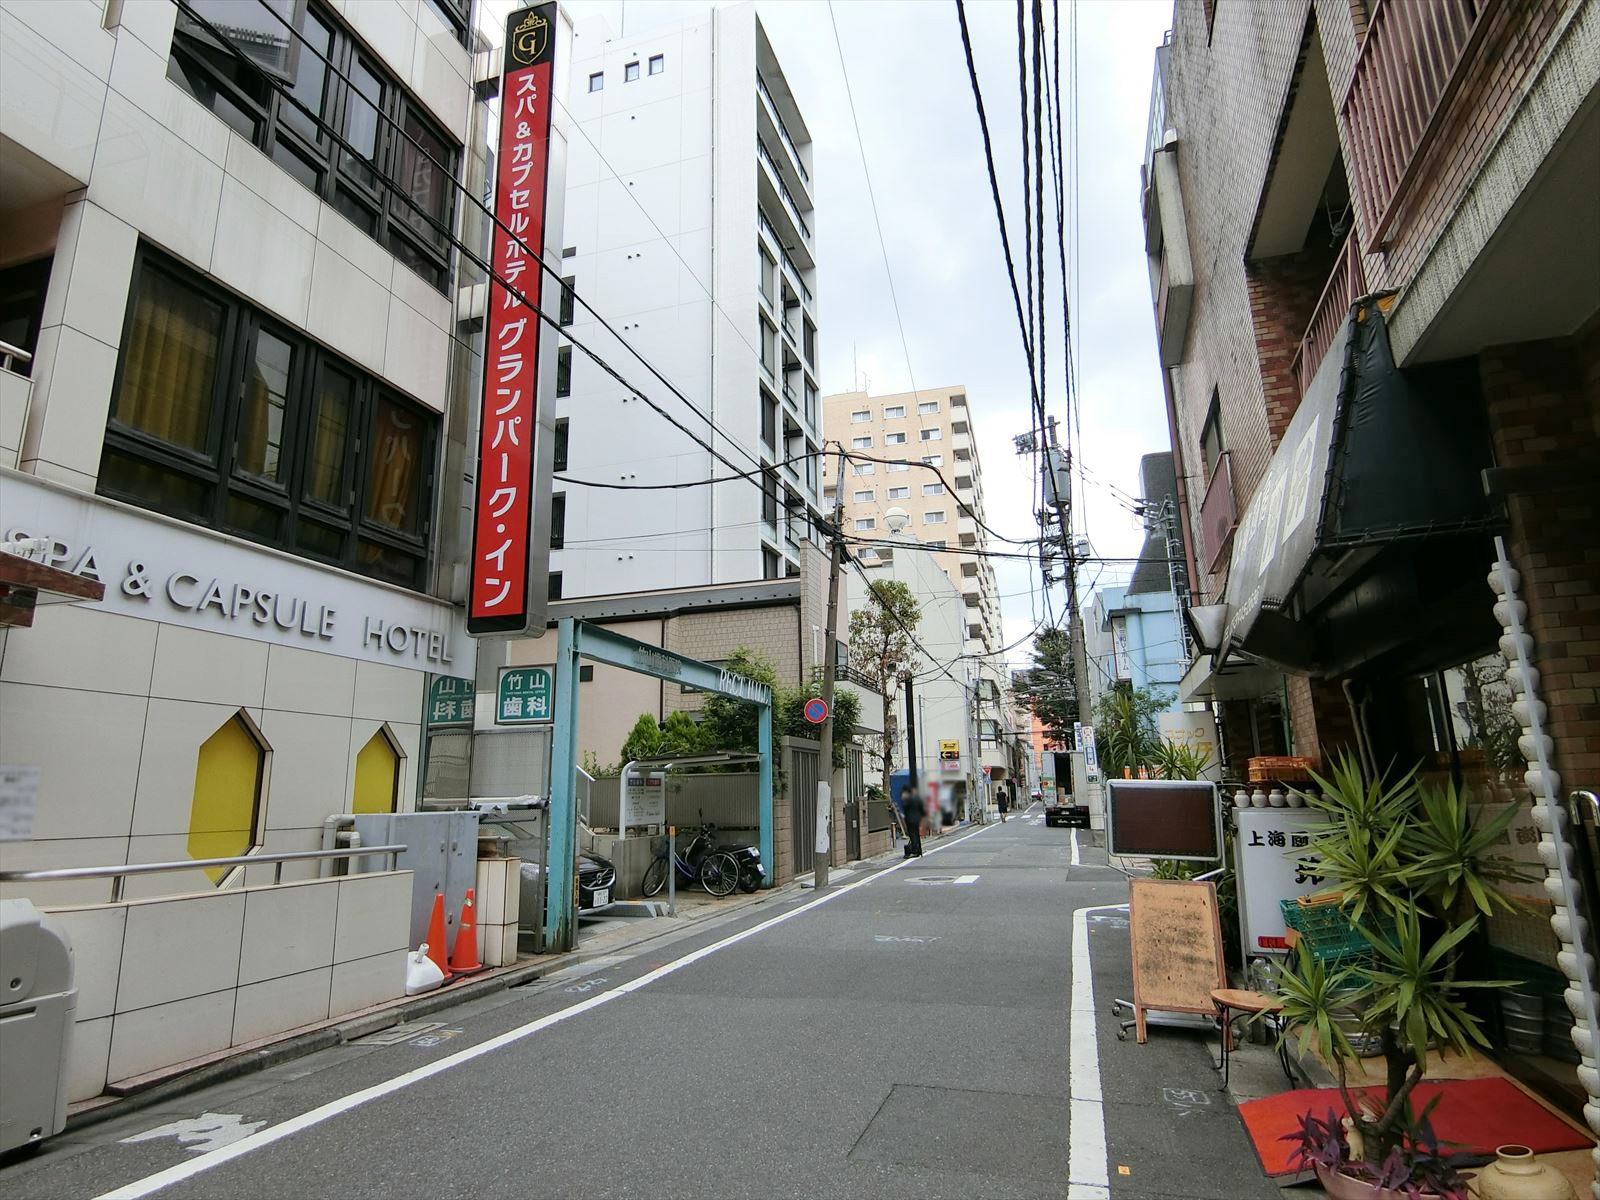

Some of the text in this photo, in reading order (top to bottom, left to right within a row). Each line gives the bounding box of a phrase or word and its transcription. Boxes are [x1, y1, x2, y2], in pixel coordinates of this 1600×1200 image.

[518, 32, 537, 55] G
[120, 559, 152, 600] &
[165, 570, 337, 639] CAPSULE
[363, 614, 453, 662] HOTEL
[507, 673, 546, 691] 竹山
[503, 695, 547, 717] 歯科
